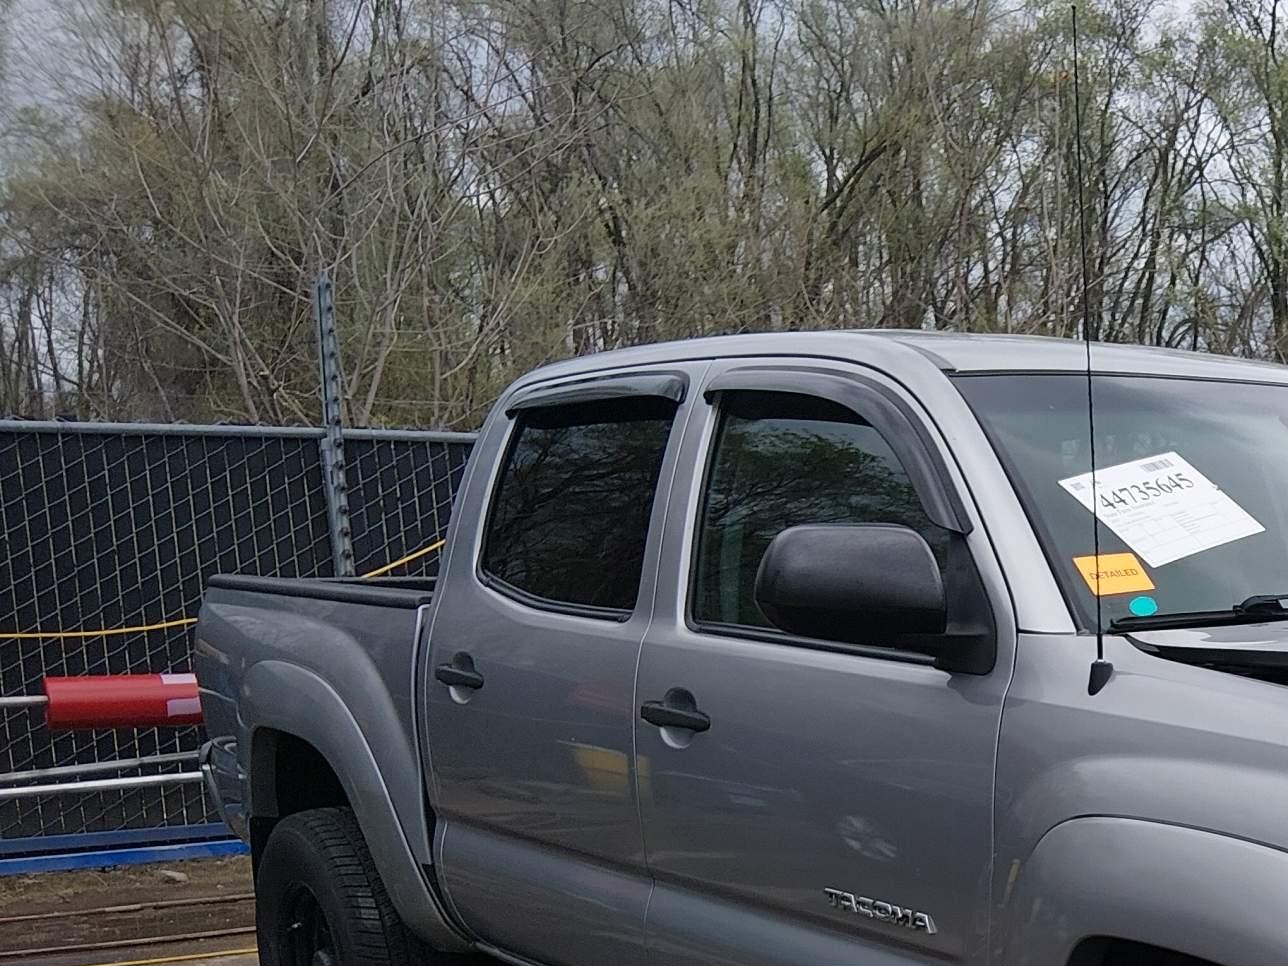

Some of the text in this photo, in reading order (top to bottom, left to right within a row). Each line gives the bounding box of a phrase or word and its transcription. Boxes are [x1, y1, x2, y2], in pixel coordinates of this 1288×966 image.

[1100, 473, 1194, 509] 44735645
[1089, 568, 1138, 580] DETAILED
[823, 886, 938, 935] TACOMA
